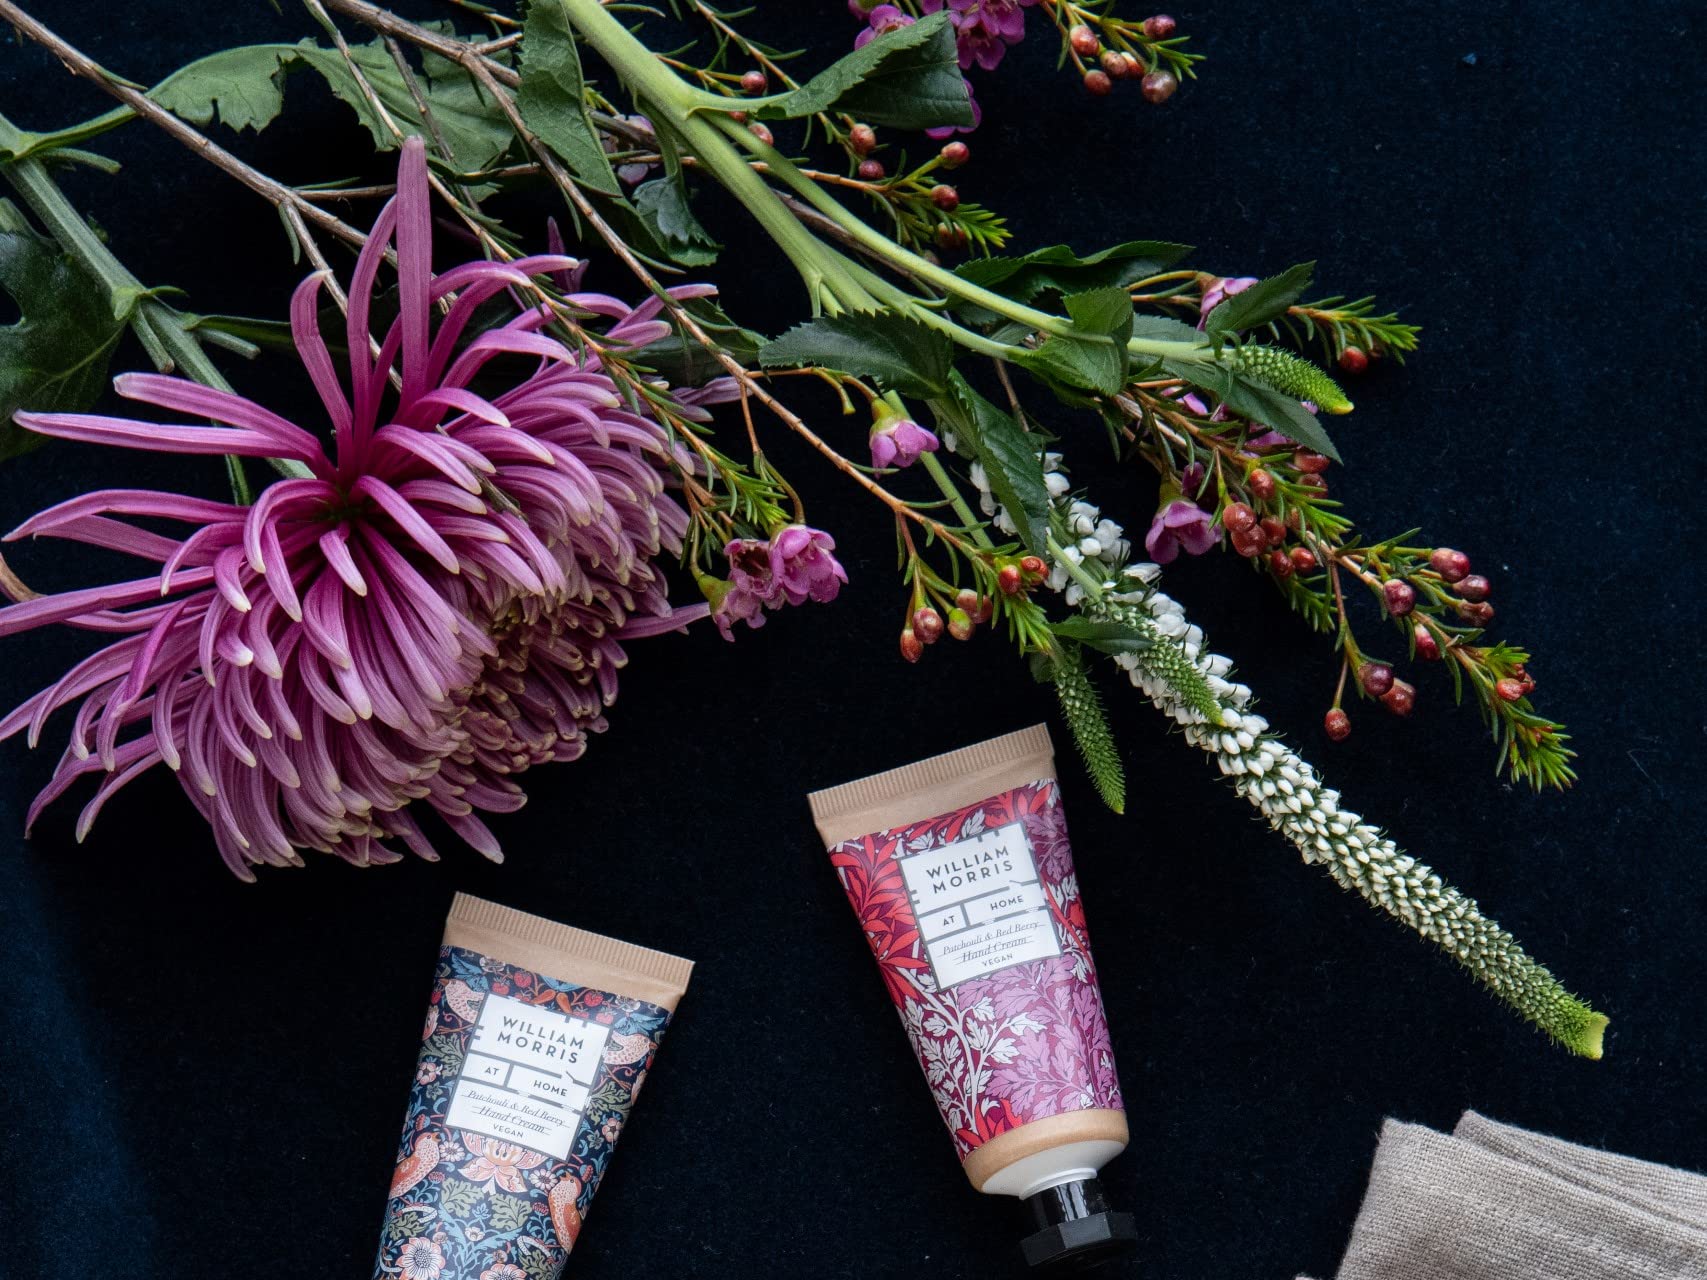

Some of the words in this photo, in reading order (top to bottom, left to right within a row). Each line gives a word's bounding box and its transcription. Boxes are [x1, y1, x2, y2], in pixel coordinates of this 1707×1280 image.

[926, 846, 1008, 878] WILLIAM
[933, 861, 1013, 894] MORRIS
[943, 916, 955, 926] AT
[990, 895, 1024, 910] HOME
[985, 932, 992, 940] &
[996, 926, 1012, 938] Red
[961, 947, 992, 963] Hand
[994, 937, 1026, 951] Cream
[982, 954, 1013, 966] VEGAN
[503, 1016, 584, 1049] WILLIAM
[498, 1031, 578, 1064] MORRIS
[485, 1066, 499, 1076] AT
[534, 1080, 568, 1097] HOME
[479, 1106, 509, 1121] Hand
[511, 1115, 545, 1133] Cream
[510, 1102, 518, 1110] &
[521, 1105, 540, 1118] Red
[493, 1124, 523, 1138] VEGAN
